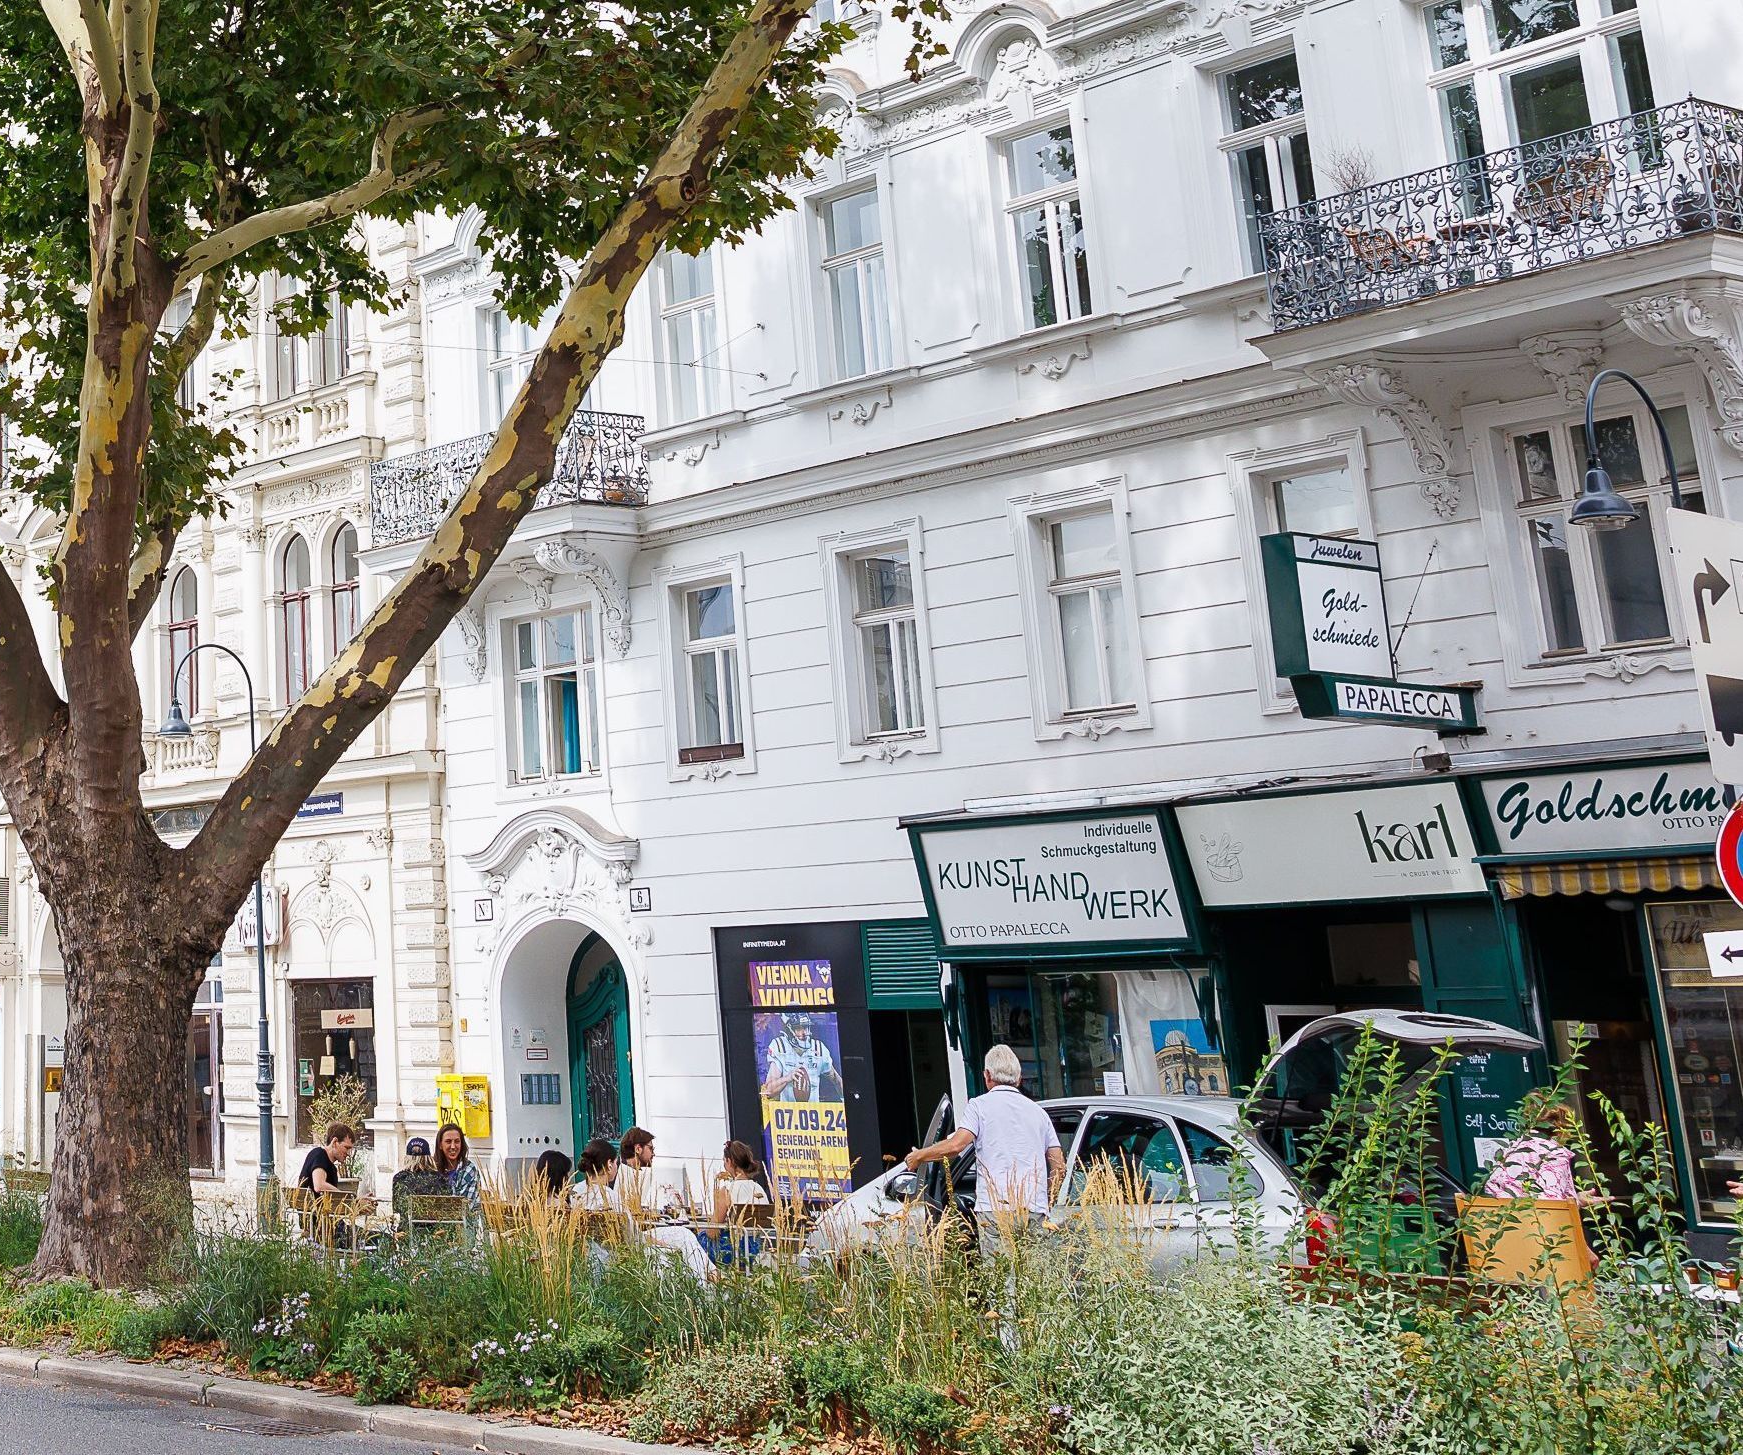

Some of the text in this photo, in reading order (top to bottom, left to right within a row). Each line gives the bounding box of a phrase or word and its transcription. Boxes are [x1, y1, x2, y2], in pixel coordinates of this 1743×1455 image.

[1309, 538, 1363, 561] Juwelen
[1322, 588, 1368, 618] Gold-
[1313, 621, 1380, 648] schmiede
[1345, 685, 1455, 718] PAPALECCA
[1083, 821, 1153, 838] Individuelle
[1354, 803, 1458, 863] karl
[1662, 817, 1704, 829] OTTO
[1040, 840, 1157, 859] Schmuckgestaltung
[636, 890, 643, 904] 6
[950, 922, 1070, 938] OTTO PAPALECCA
[756, 965, 812, 985] VIENNA
[775, 1108, 847, 1131] 07.09.24
